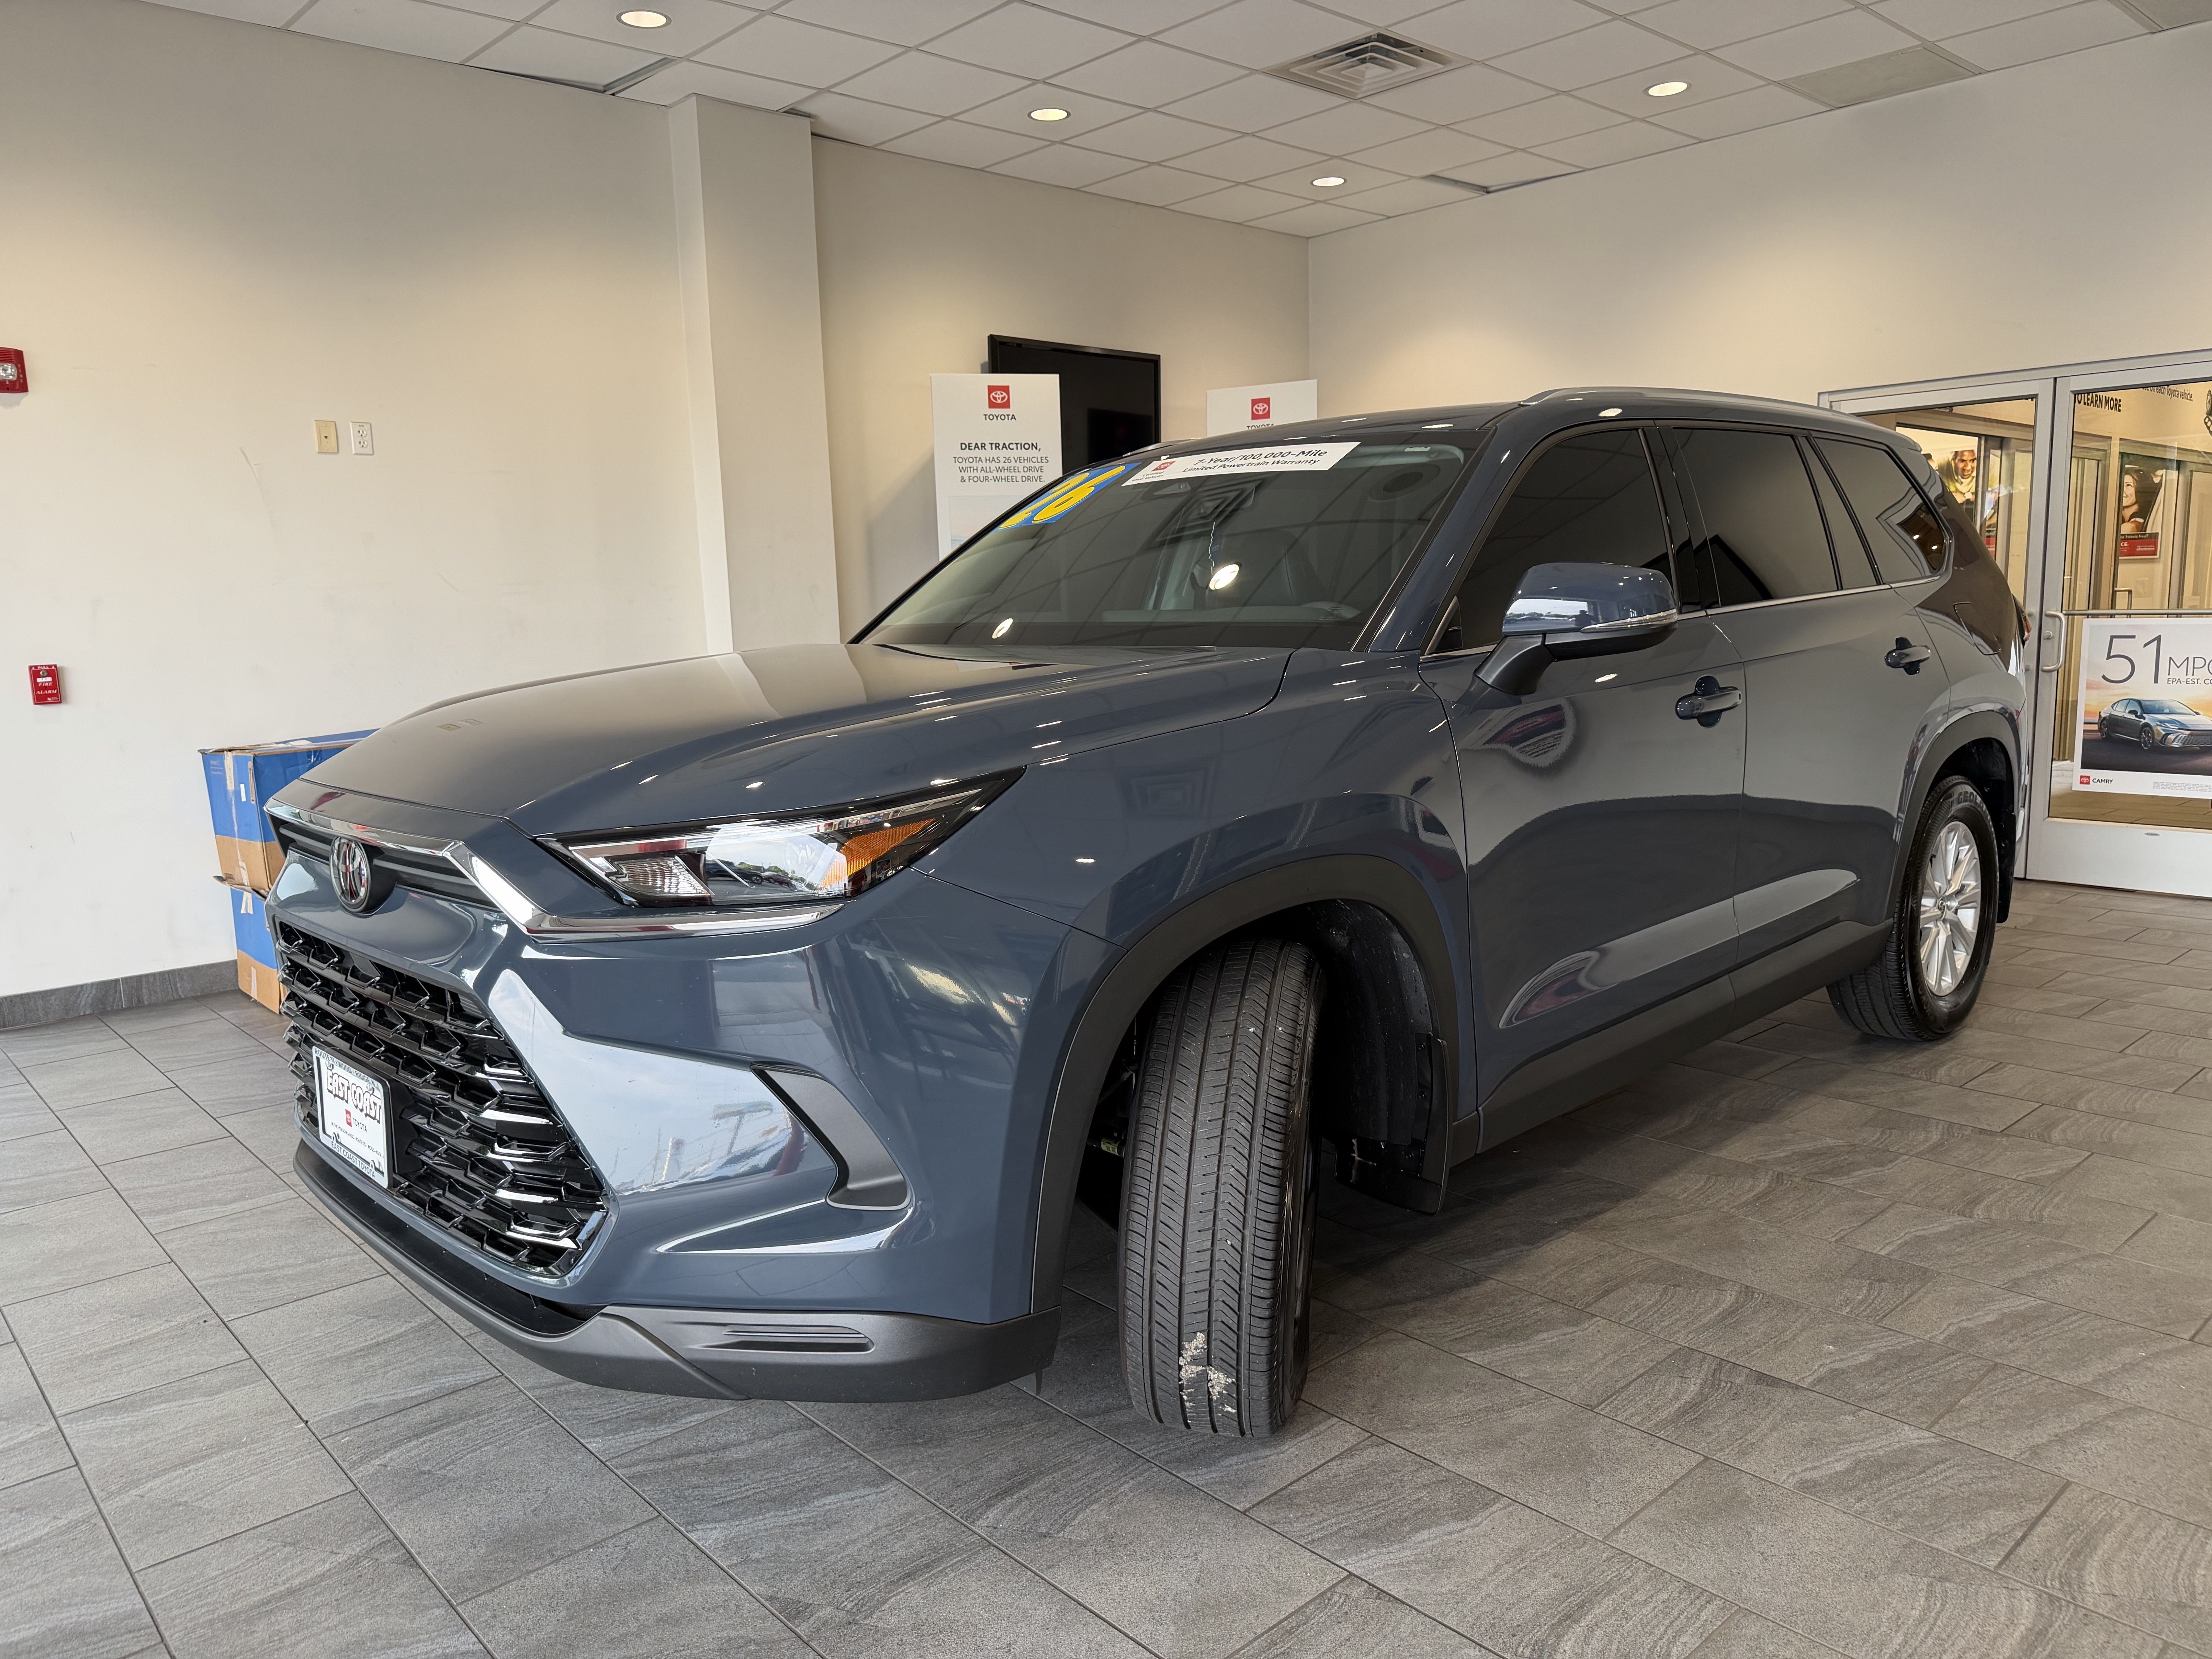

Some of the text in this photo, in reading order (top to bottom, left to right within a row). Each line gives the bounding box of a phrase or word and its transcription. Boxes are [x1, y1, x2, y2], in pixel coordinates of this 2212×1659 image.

[2083, 393, 2103, 409] LEARN
[2104, 395, 2122, 412] MORE
[989, 442, 1041, 452] TRACTION,
[1194, 449, 1328, 466] 7-Year/100,000-Mile
[1182, 464, 1218, 472] Limited
[1218, 461, 1269, 469] Powertrain
[2101, 634, 2212, 684] 51 MP
[315, 1048, 330, 1061] ROUTE
[326, 1069, 382, 1124] EAST COAST
[352, 1117, 368, 1133] TOYOTA
[331, 1140, 376, 1179] EAST COAST TOYOTA
